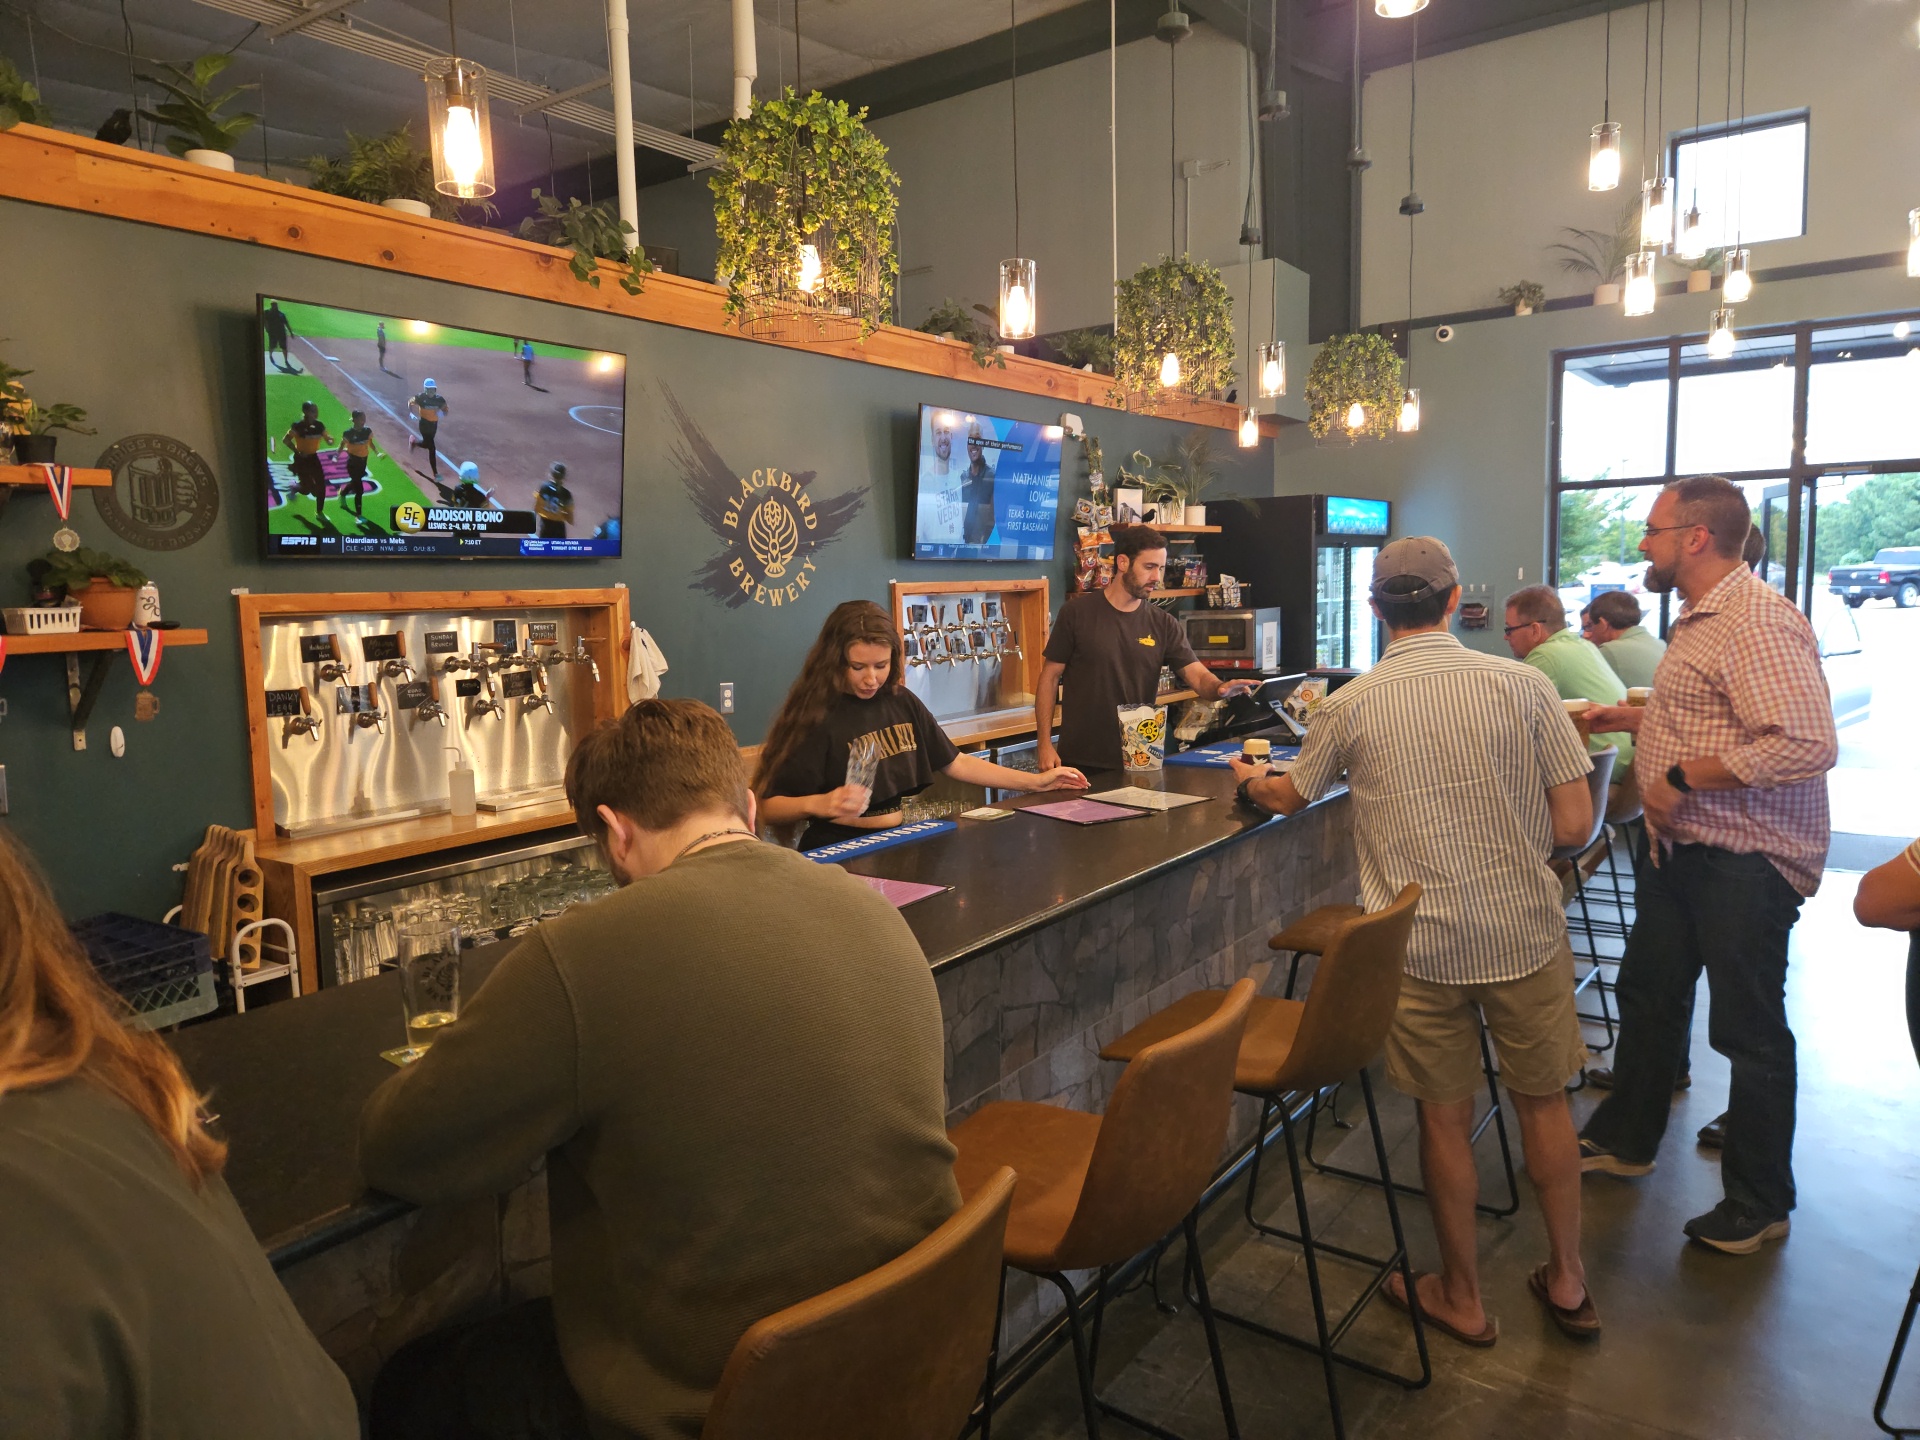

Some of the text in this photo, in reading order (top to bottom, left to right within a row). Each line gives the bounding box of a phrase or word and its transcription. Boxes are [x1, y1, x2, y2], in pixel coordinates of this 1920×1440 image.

[167, 443, 209, 486] BREWS
[723, 467, 817, 529] BLACKBIRD
[1029, 490, 1050, 502] LOWE
[168, 503, 213, 546] BREWERY
[428, 509, 504, 523] ADDISON BONO
[1007, 521, 1049, 532] FIRST BASEMAN
[1008, 509, 1050, 520] TEXAS RANGERS
[729, 555, 816, 606] BREWERY
[268, 691, 299, 702] DANKY
[808, 821, 943, 859] CATHEAD VODKA
